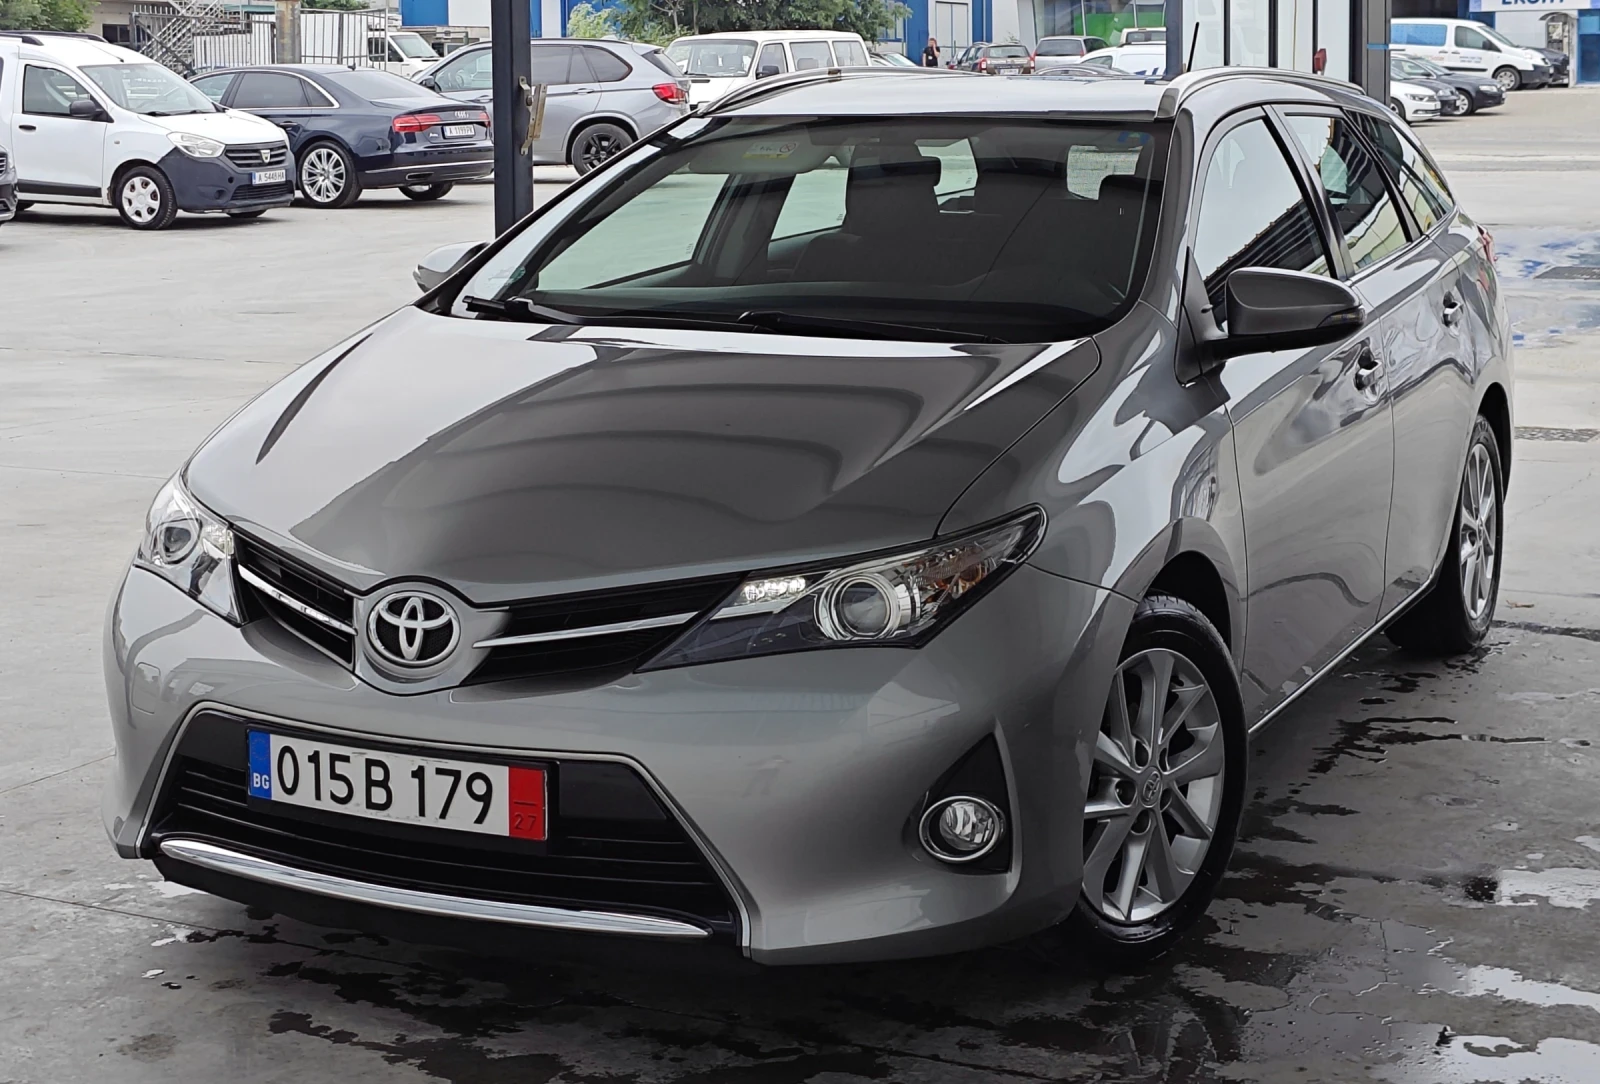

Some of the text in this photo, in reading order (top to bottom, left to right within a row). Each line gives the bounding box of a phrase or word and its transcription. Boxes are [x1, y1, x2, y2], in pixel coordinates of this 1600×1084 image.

[253, 773, 270, 789] BG
[365, 758, 393, 811] B
[411, 765, 493, 824] 179
[513, 812, 537, 832] 27
